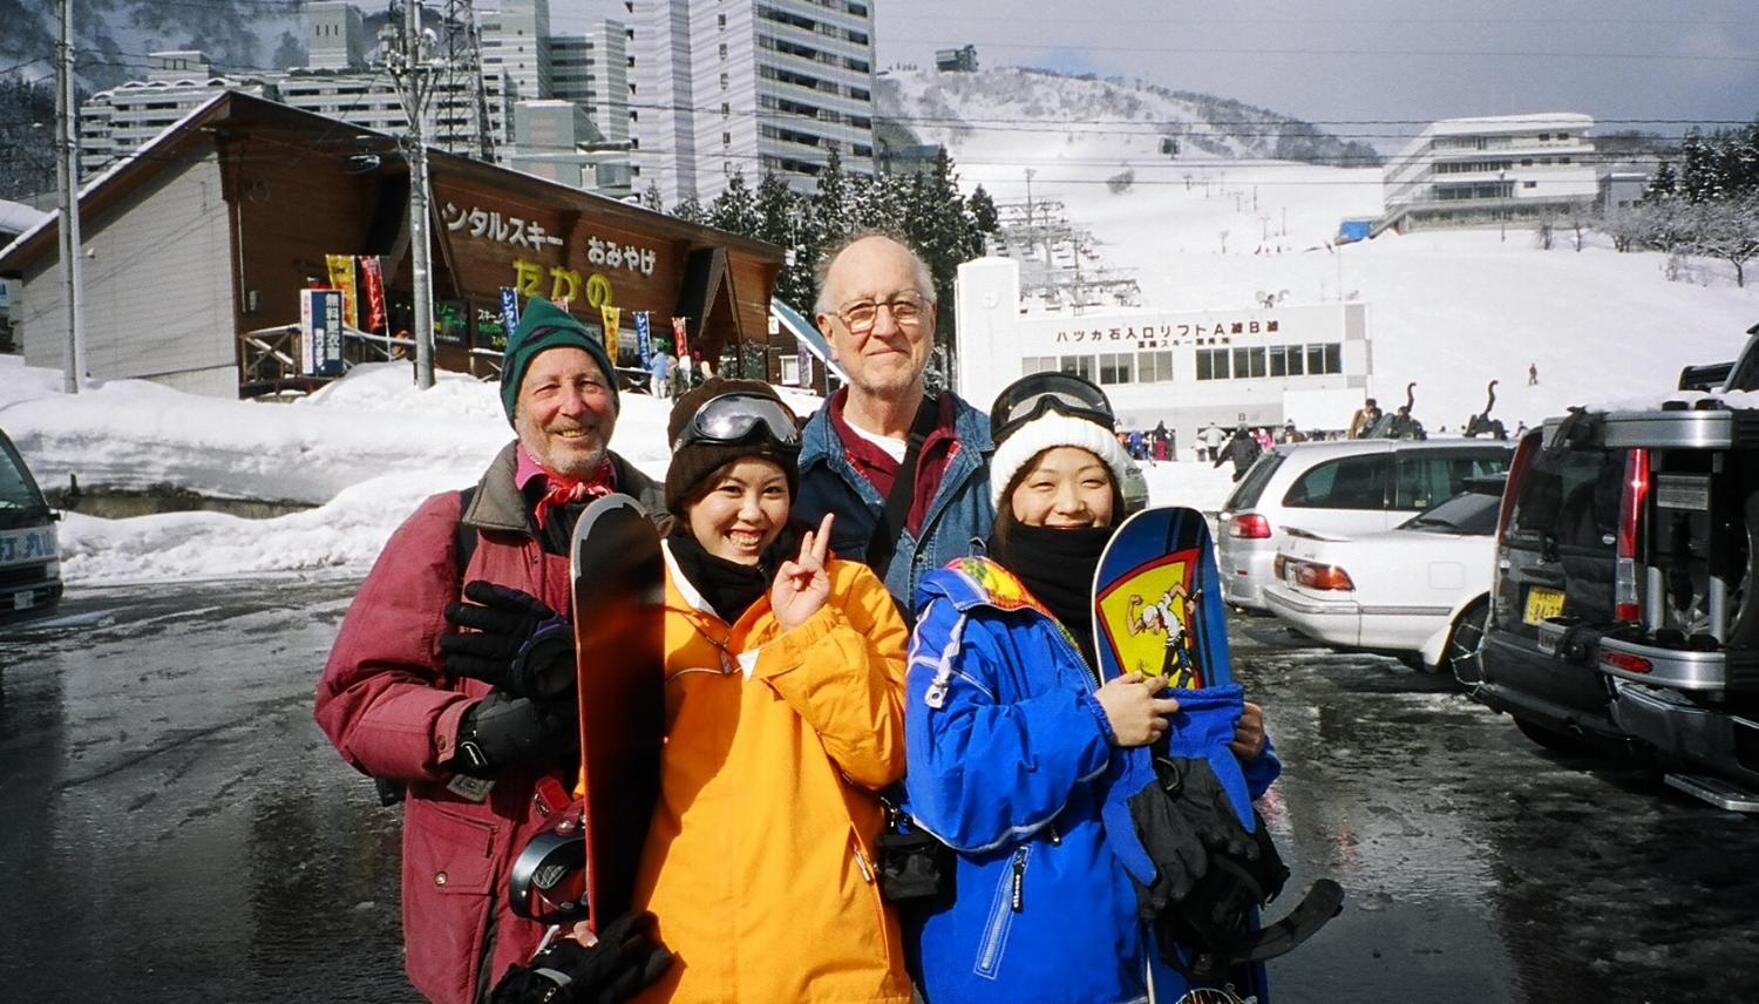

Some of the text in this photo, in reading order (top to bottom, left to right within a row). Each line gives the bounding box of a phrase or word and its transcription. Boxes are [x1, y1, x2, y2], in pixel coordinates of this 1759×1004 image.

[441, 201, 564, 252] ンタルスキー
[587, 235, 657, 276] おみやげ
[512, 257, 613, 309] たかの
